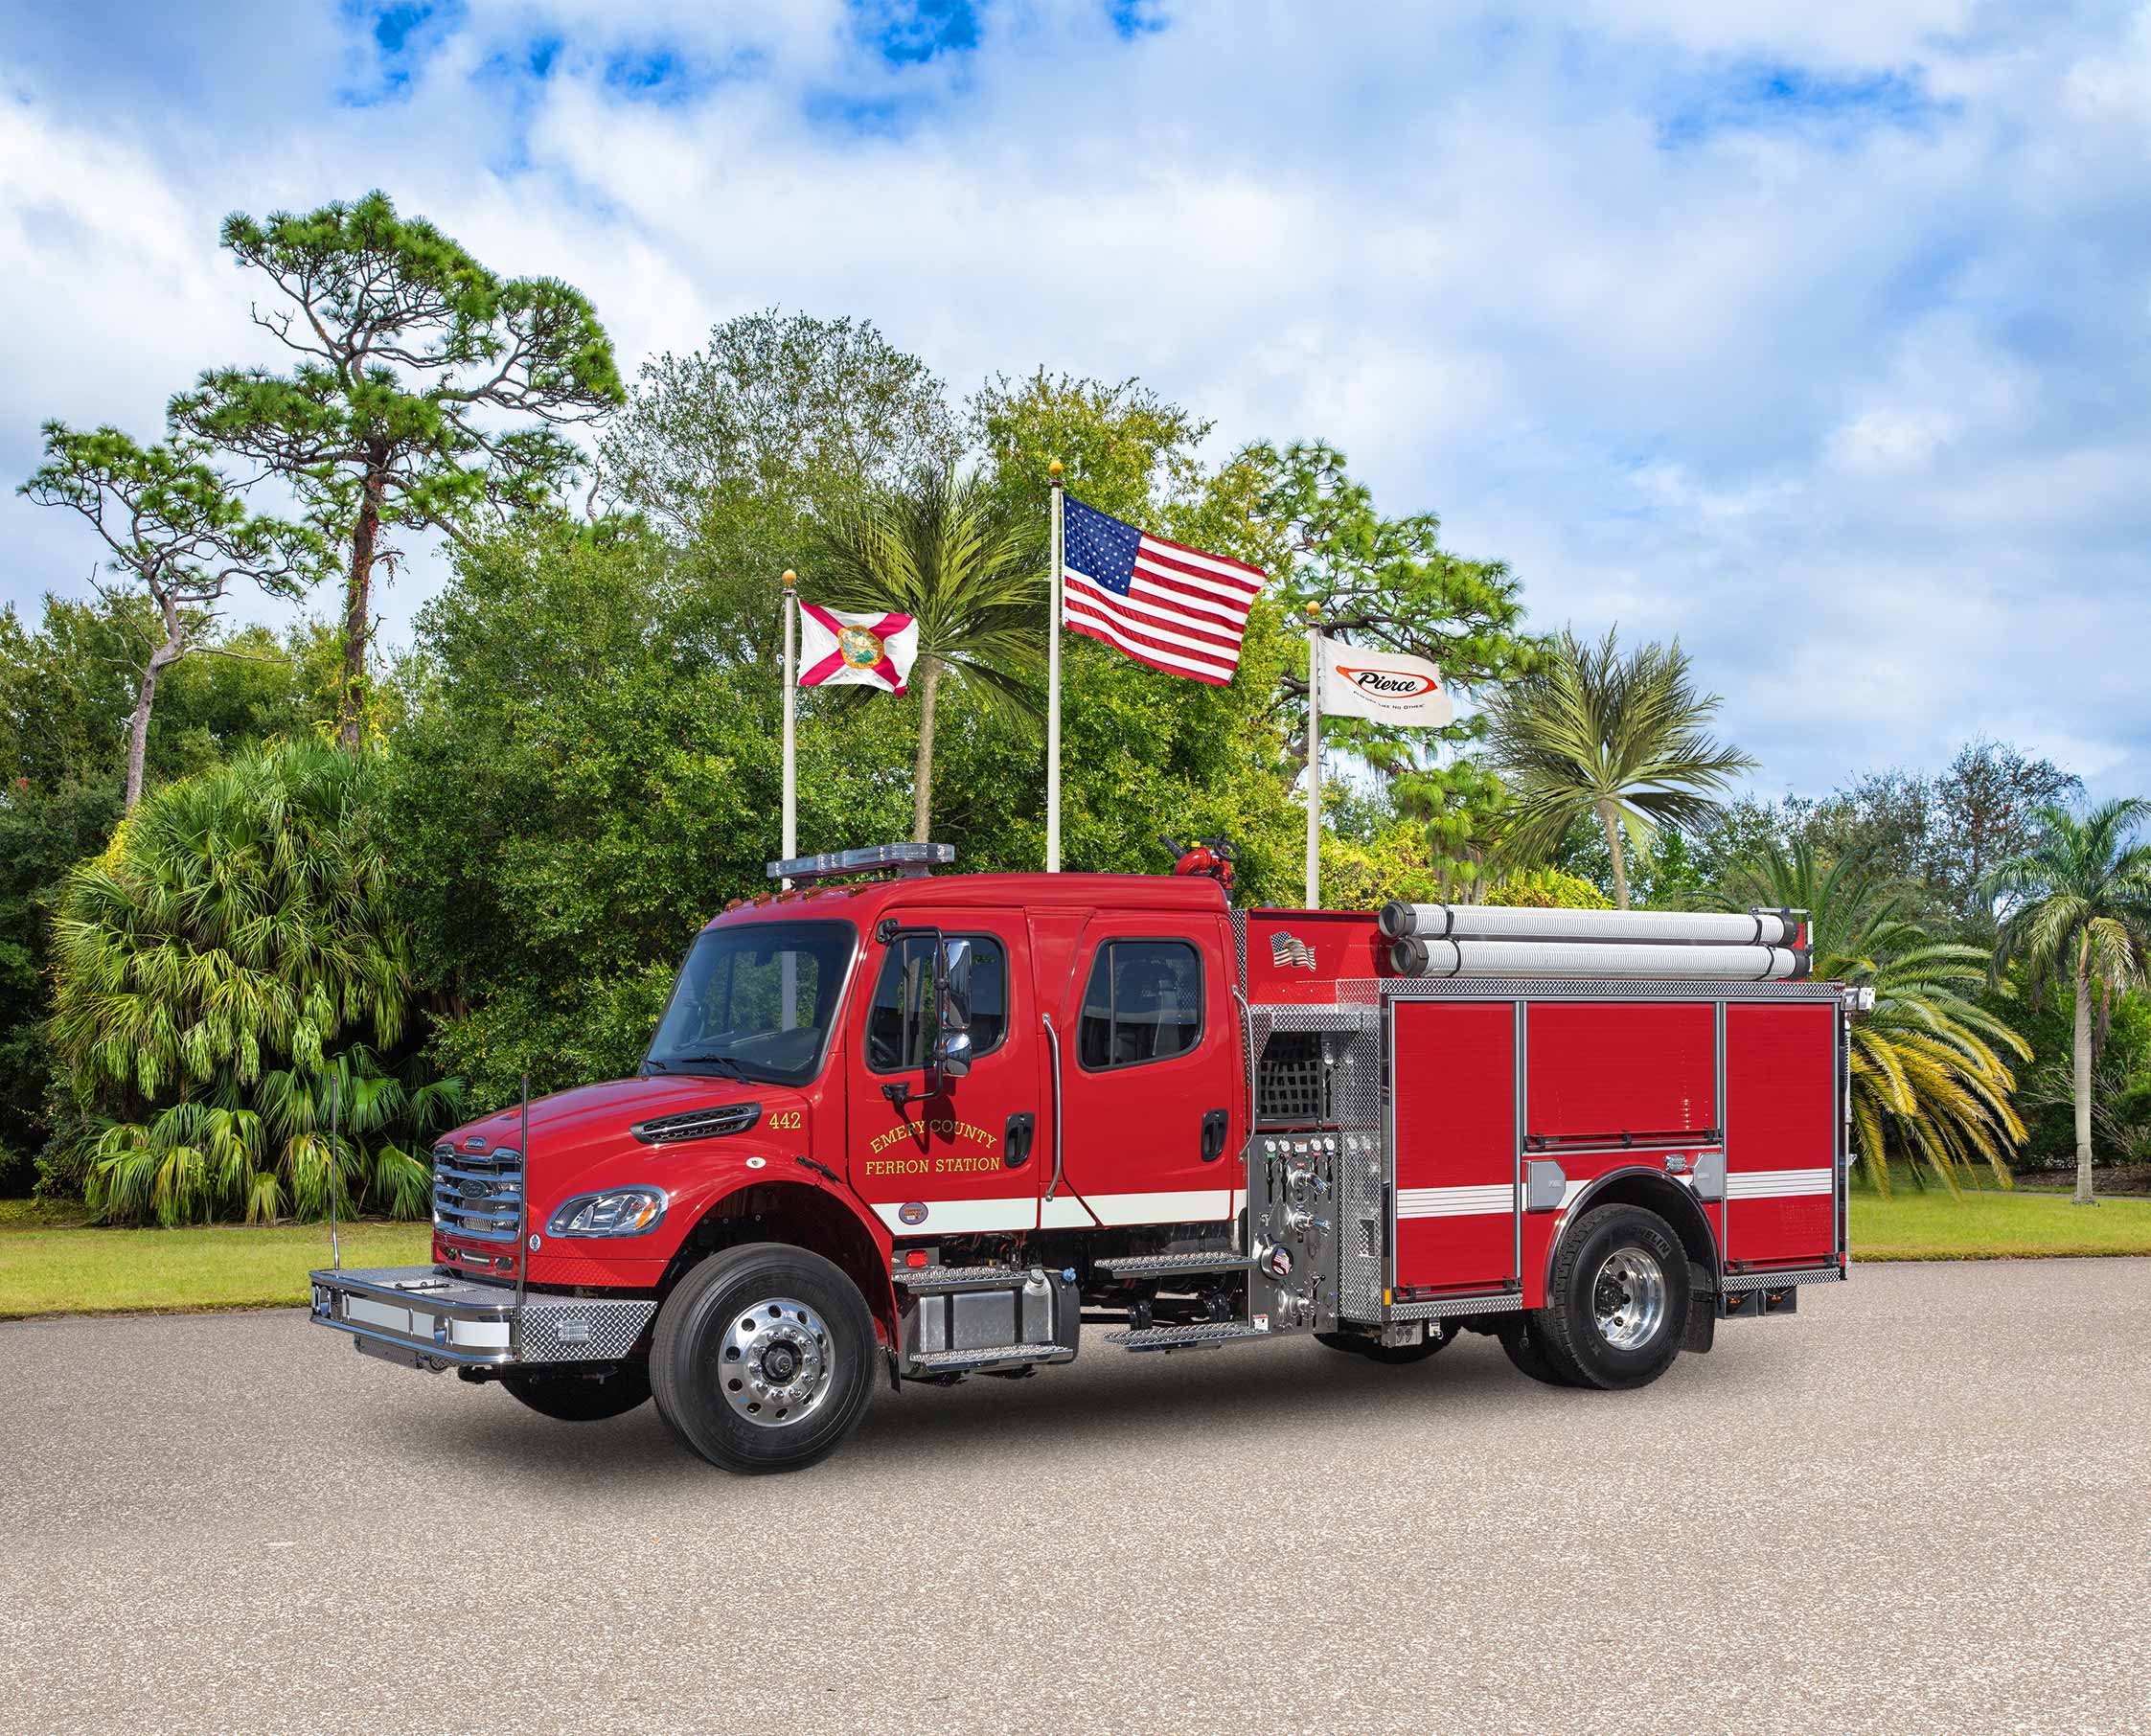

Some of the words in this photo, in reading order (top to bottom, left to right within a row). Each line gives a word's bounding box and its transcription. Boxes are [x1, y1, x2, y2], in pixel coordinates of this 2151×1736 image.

[1358, 672, 1416, 692] Pierce
[768, 1112, 801, 1130] 442
[869, 1120, 927, 1154] EMERY
[929, 1118, 997, 1150] COUNTY
[865, 1159, 930, 1176] FERRON
[935, 1156, 1001, 1173] STATION
